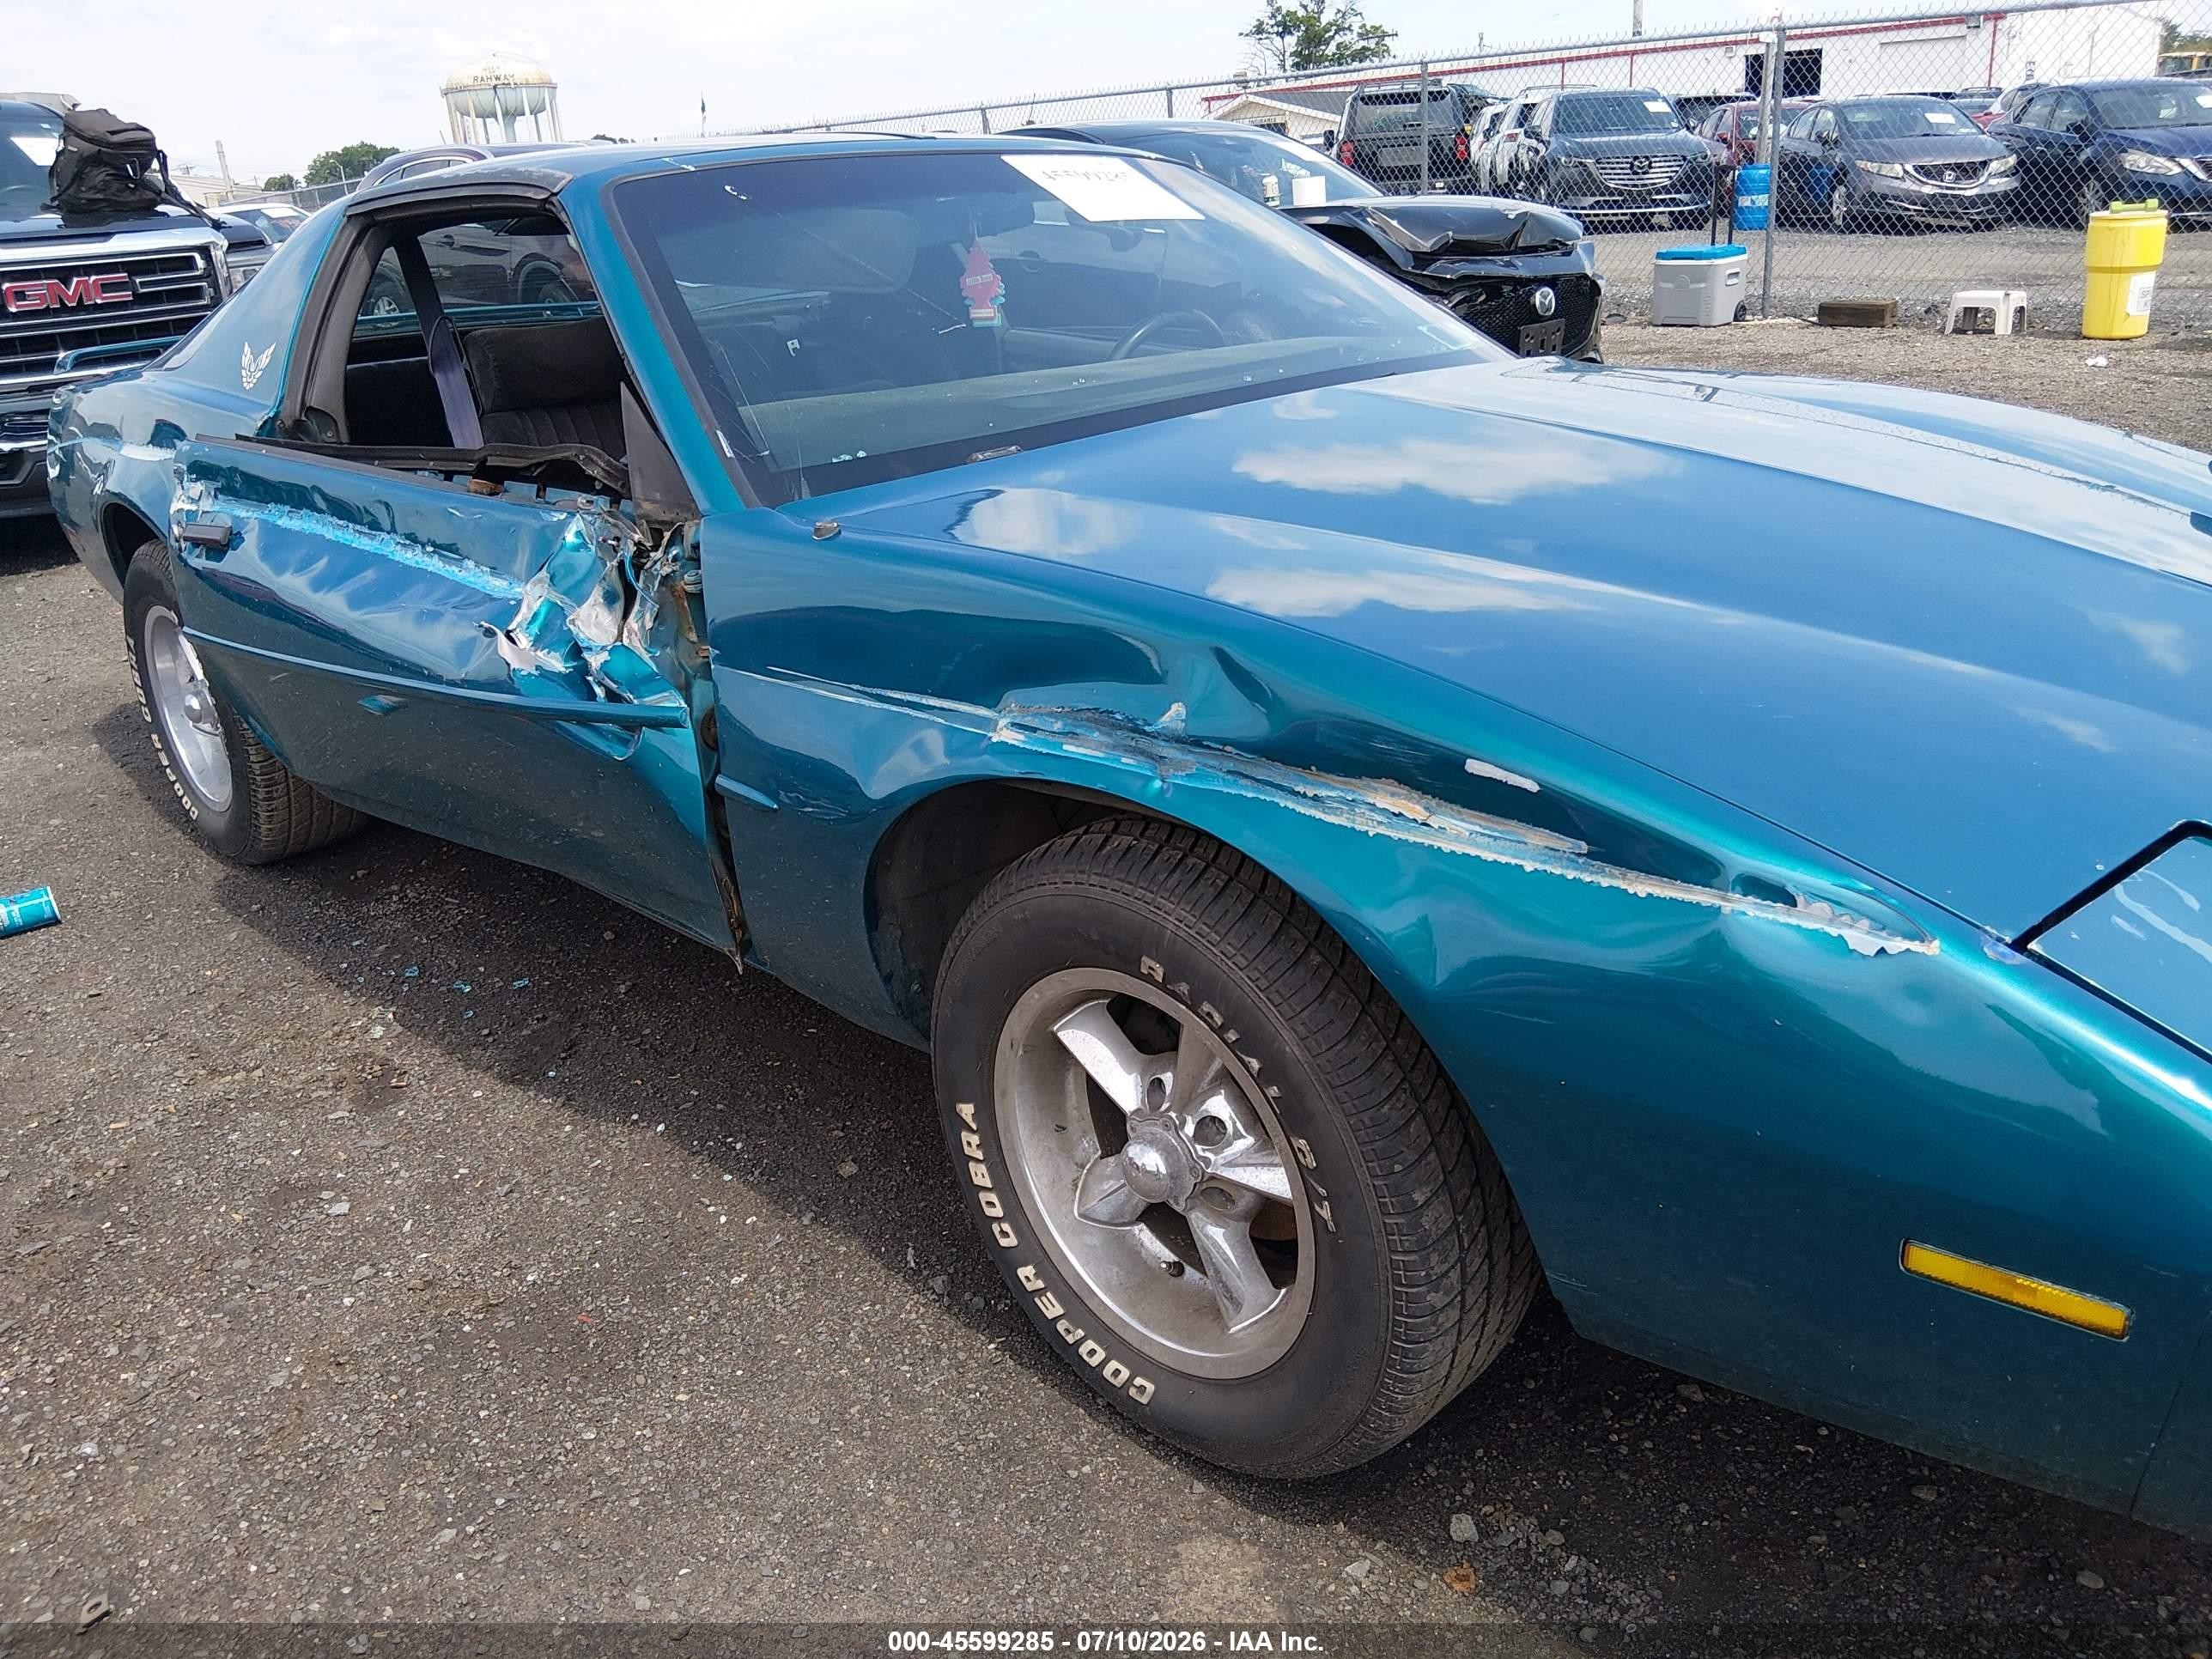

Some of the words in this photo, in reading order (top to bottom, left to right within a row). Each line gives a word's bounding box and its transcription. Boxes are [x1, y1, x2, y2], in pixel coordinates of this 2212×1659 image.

[473, 74, 515, 83] RAHWAY
[3, 273, 133, 313] GMC
[126, 635, 153, 723] COBRA
[150, 732, 199, 821] COOPER
[956, 1102, 1018, 1249] COBRA
[1017, 1264, 1156, 1406] COOPER
